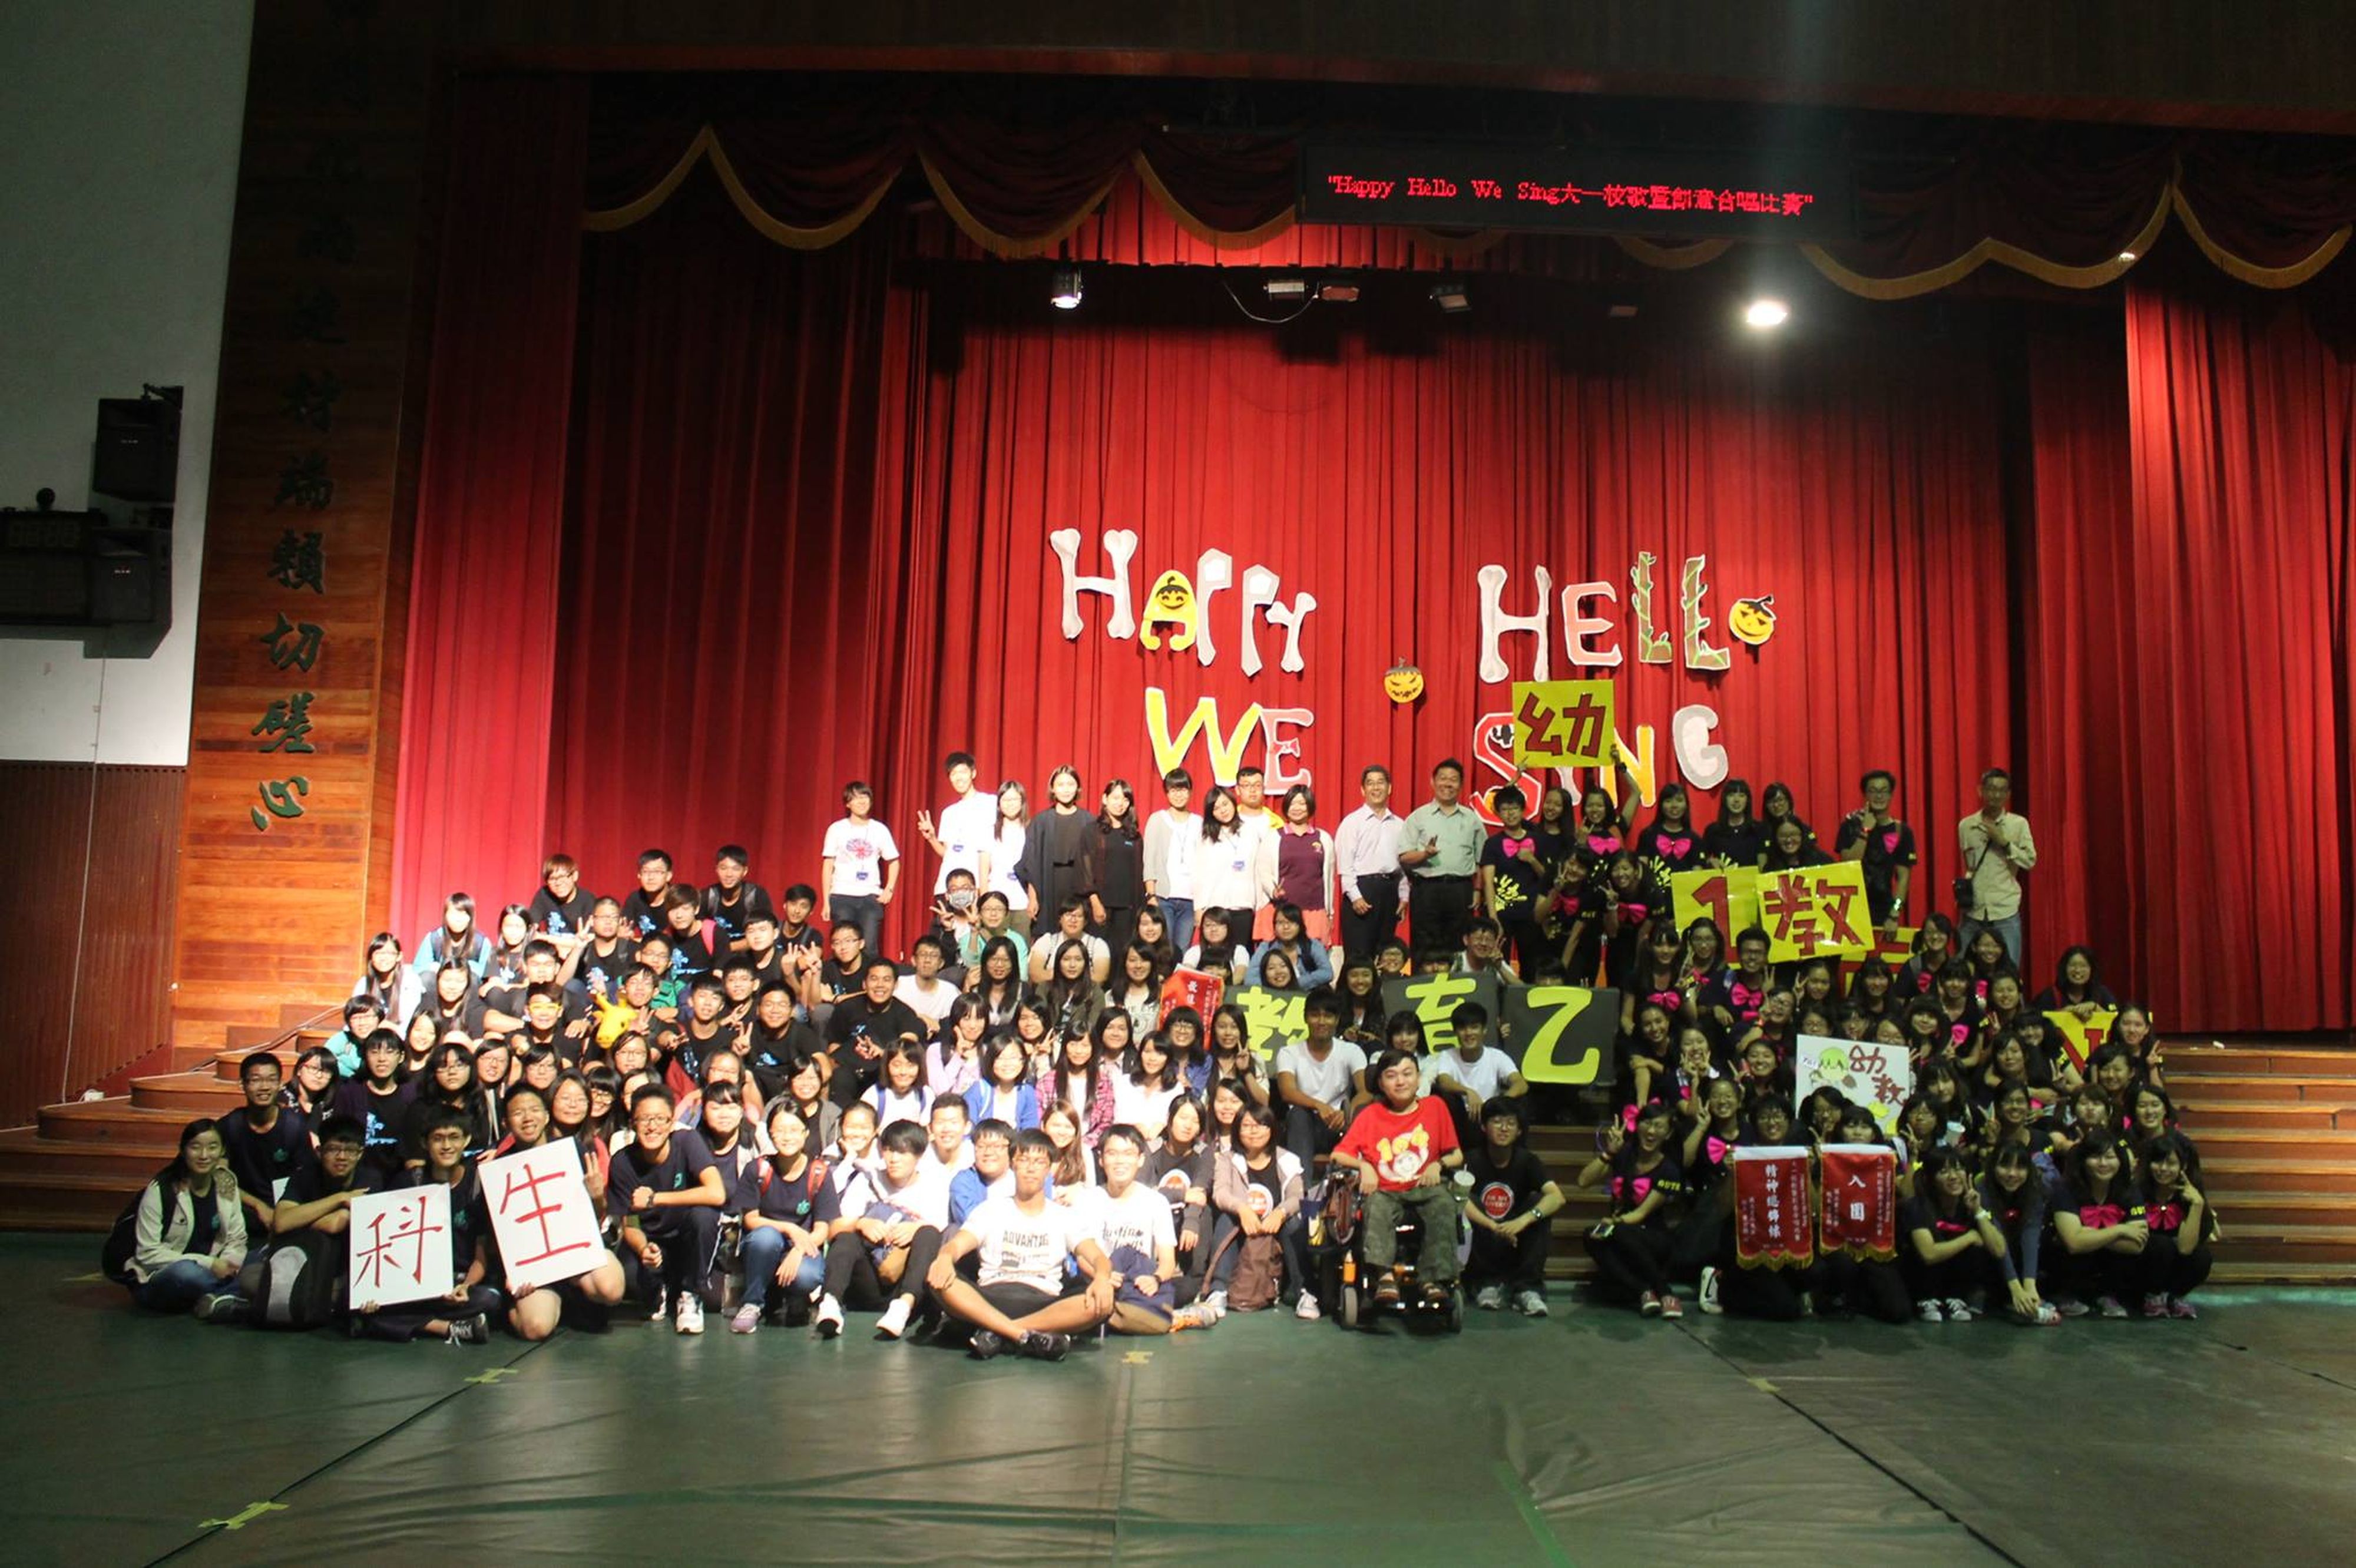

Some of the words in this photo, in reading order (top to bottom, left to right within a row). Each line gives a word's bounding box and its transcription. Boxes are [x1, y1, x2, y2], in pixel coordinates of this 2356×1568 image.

[1471, 180, 1503, 199] We
[1050, 528, 1317, 677] HAPPY
[1145, 687, 1314, 795] WE
[1469, 704, 1729, 826] SNG
[1518, 692, 1607, 758] 幼
[1763, 874, 1864, 956] 教
[1521, 985, 1601, 1085] 乙
[353, 1196, 443, 1288] 科
[499, 1164, 591, 1266] 生
